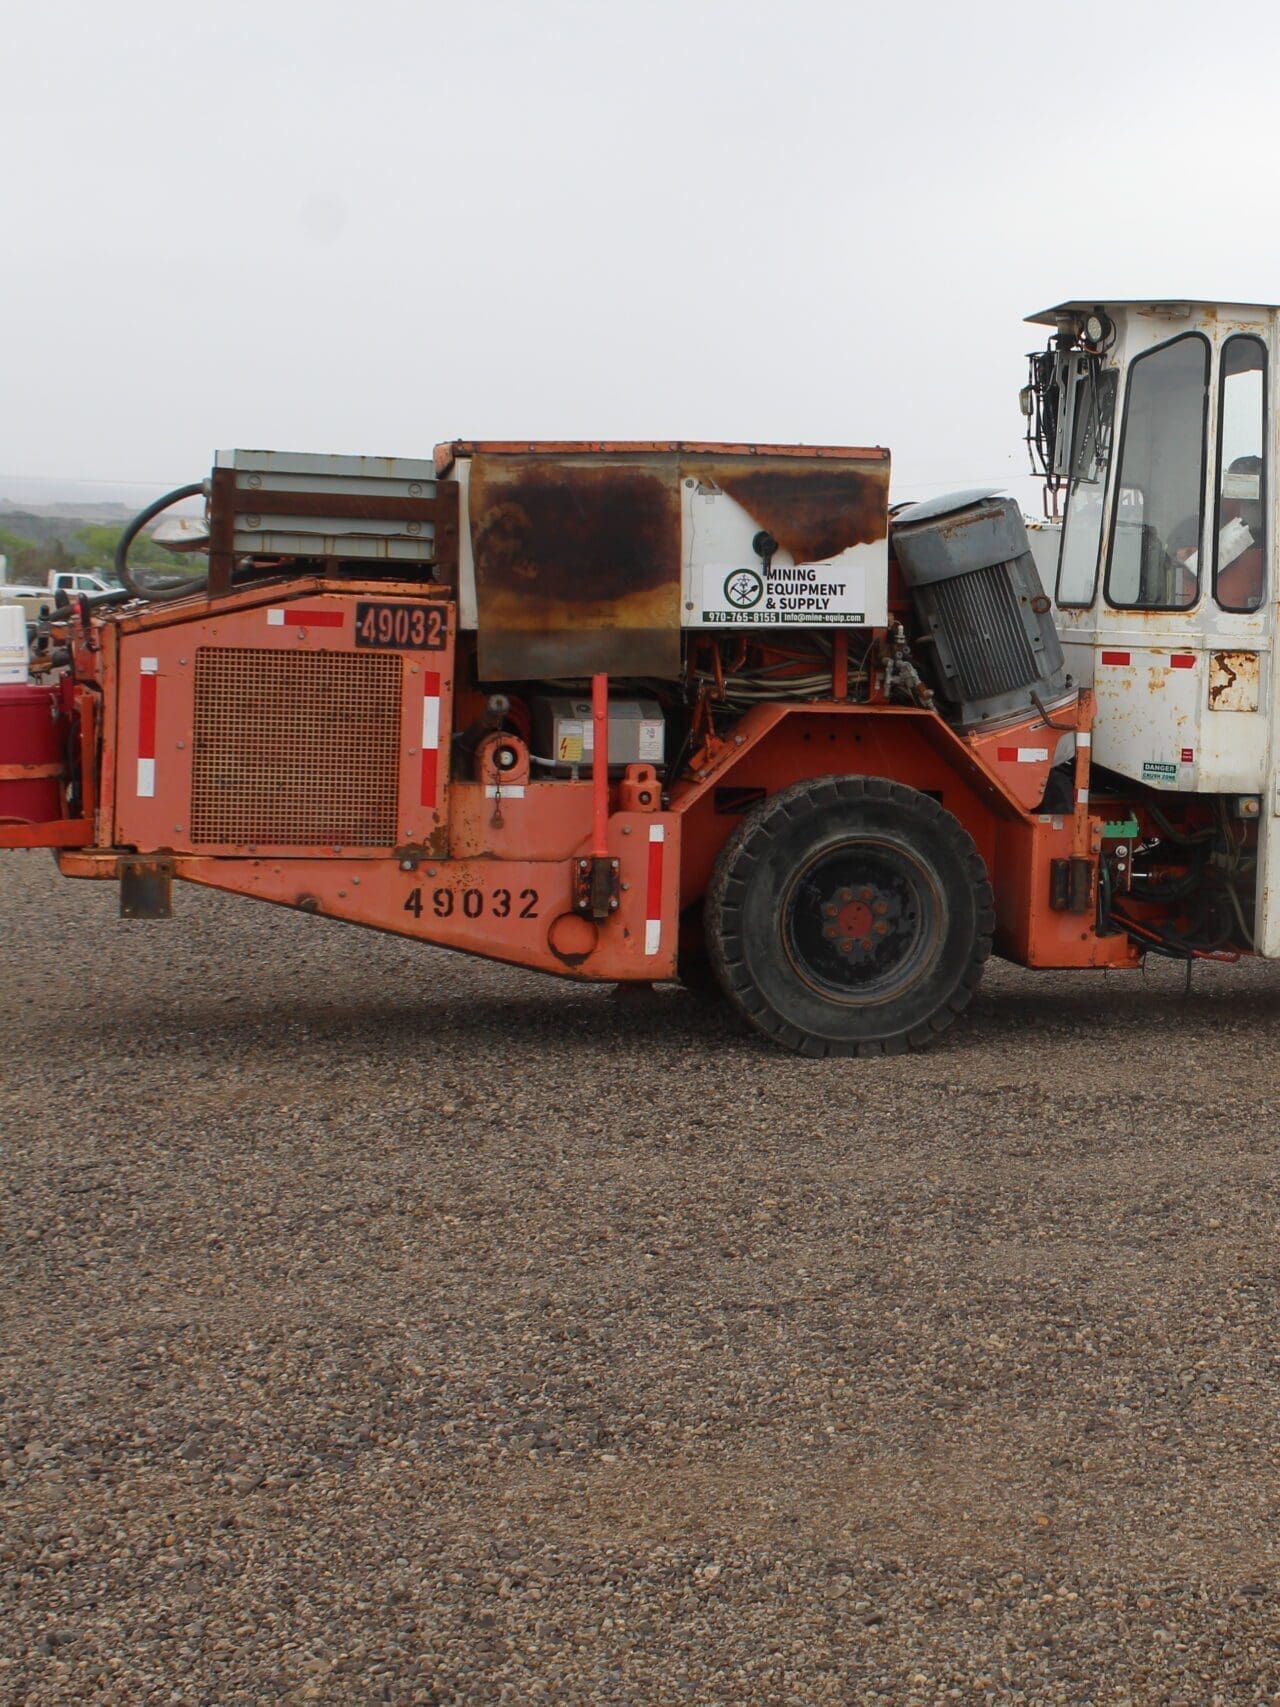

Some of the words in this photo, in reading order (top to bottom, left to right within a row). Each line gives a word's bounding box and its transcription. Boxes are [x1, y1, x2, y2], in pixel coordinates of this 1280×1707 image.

[767, 569, 816, 581] MINING
[766, 583, 846, 596] EQUIPMENT
[766, 597, 776, 610] &
[779, 598, 830, 610] SUPPLY
[708, 611, 776, 622] 970-765-8155
[361, 607, 442, 646] 49032
[404, 888, 539, 919] 49032
